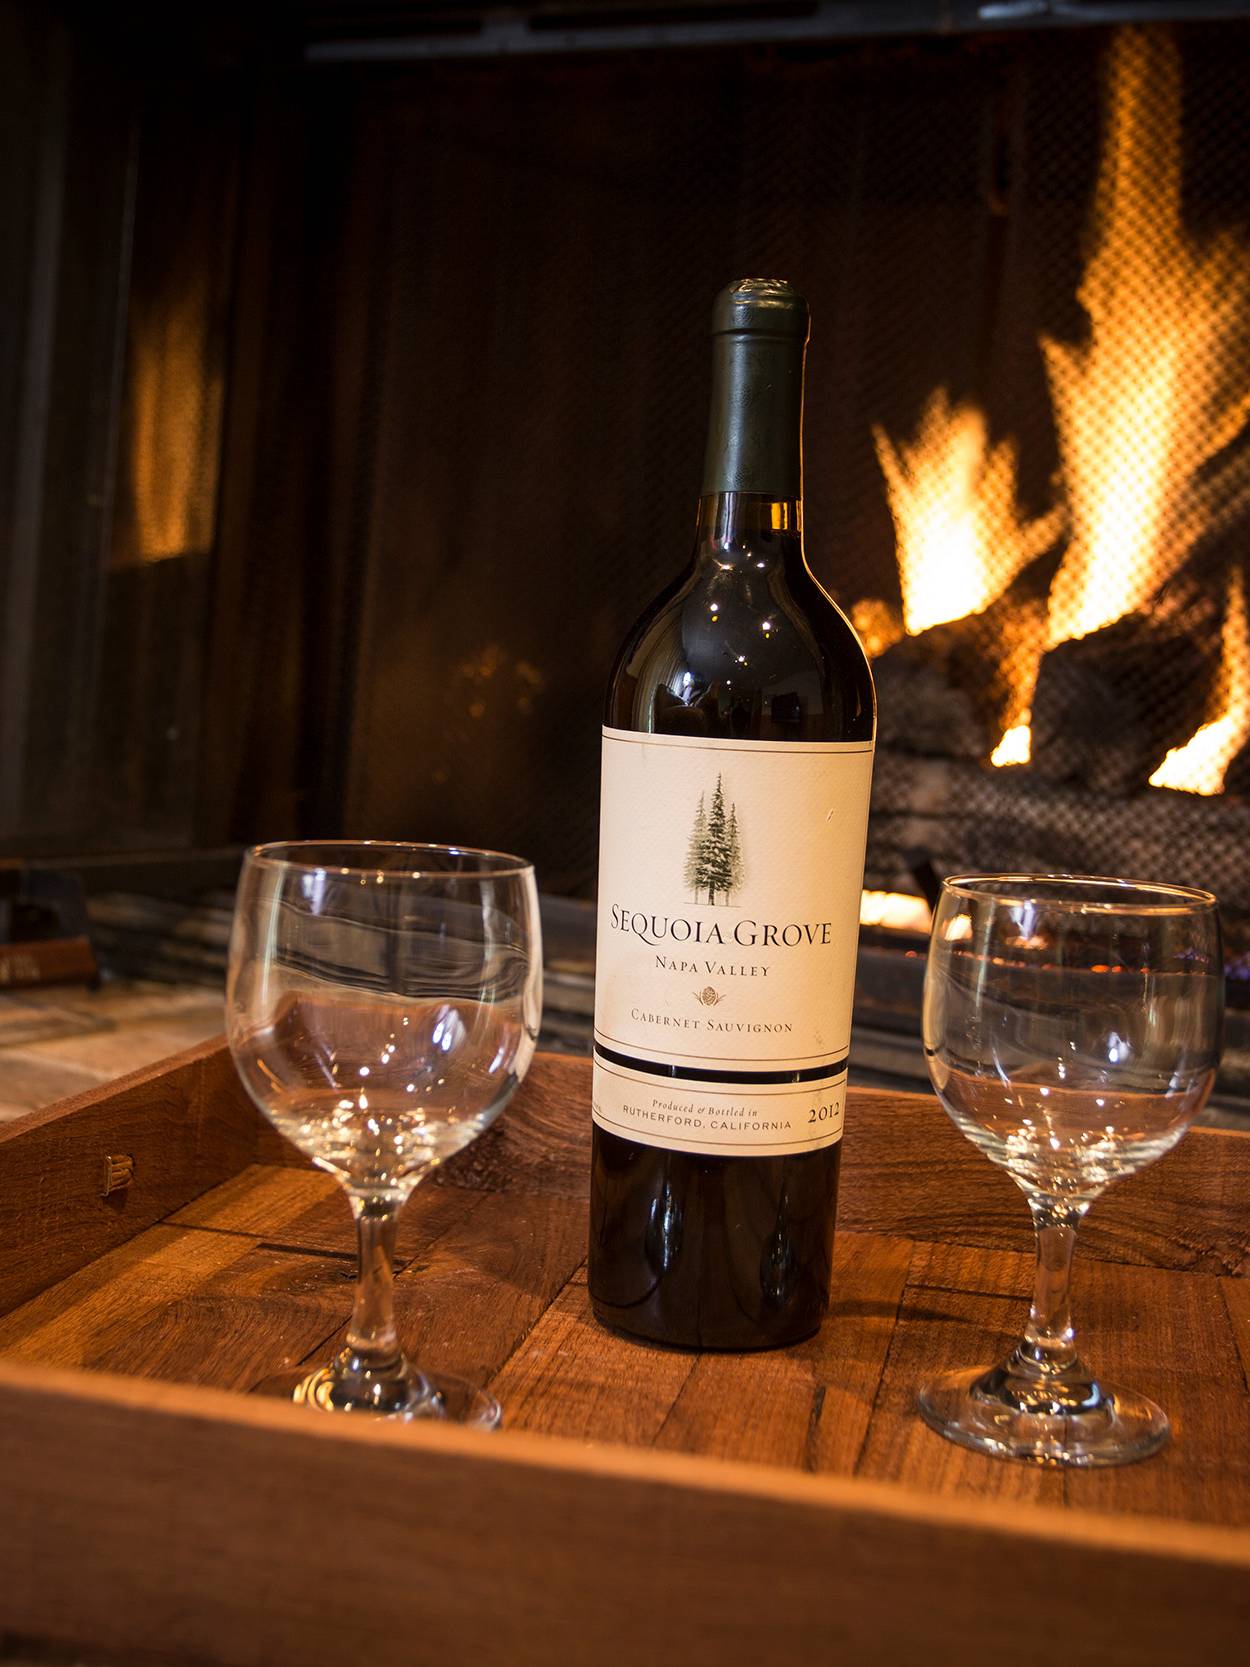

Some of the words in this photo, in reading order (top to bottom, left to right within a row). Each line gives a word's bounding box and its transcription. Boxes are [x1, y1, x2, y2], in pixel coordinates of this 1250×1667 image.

[610, 903, 724, 946] SEQUOIA
[733, 920, 832, 946] GROVE
[655, 955, 698, 973] NAPA
[704, 961, 771, 977] VALLEY
[631, 1008, 700, 1029] CABERNET
[707, 1019, 793, 1033] SAUVIGNON
[623, 1104, 706, 1129] RUTHERFORD,
[710, 1120, 792, 1131] CALIFORNIA
[652, 1099, 694, 1113] Produced
[708, 1106, 745, 1117] Bottled
[748, 1109, 758, 1117] in
[807, 1102, 840, 1124] 2012
